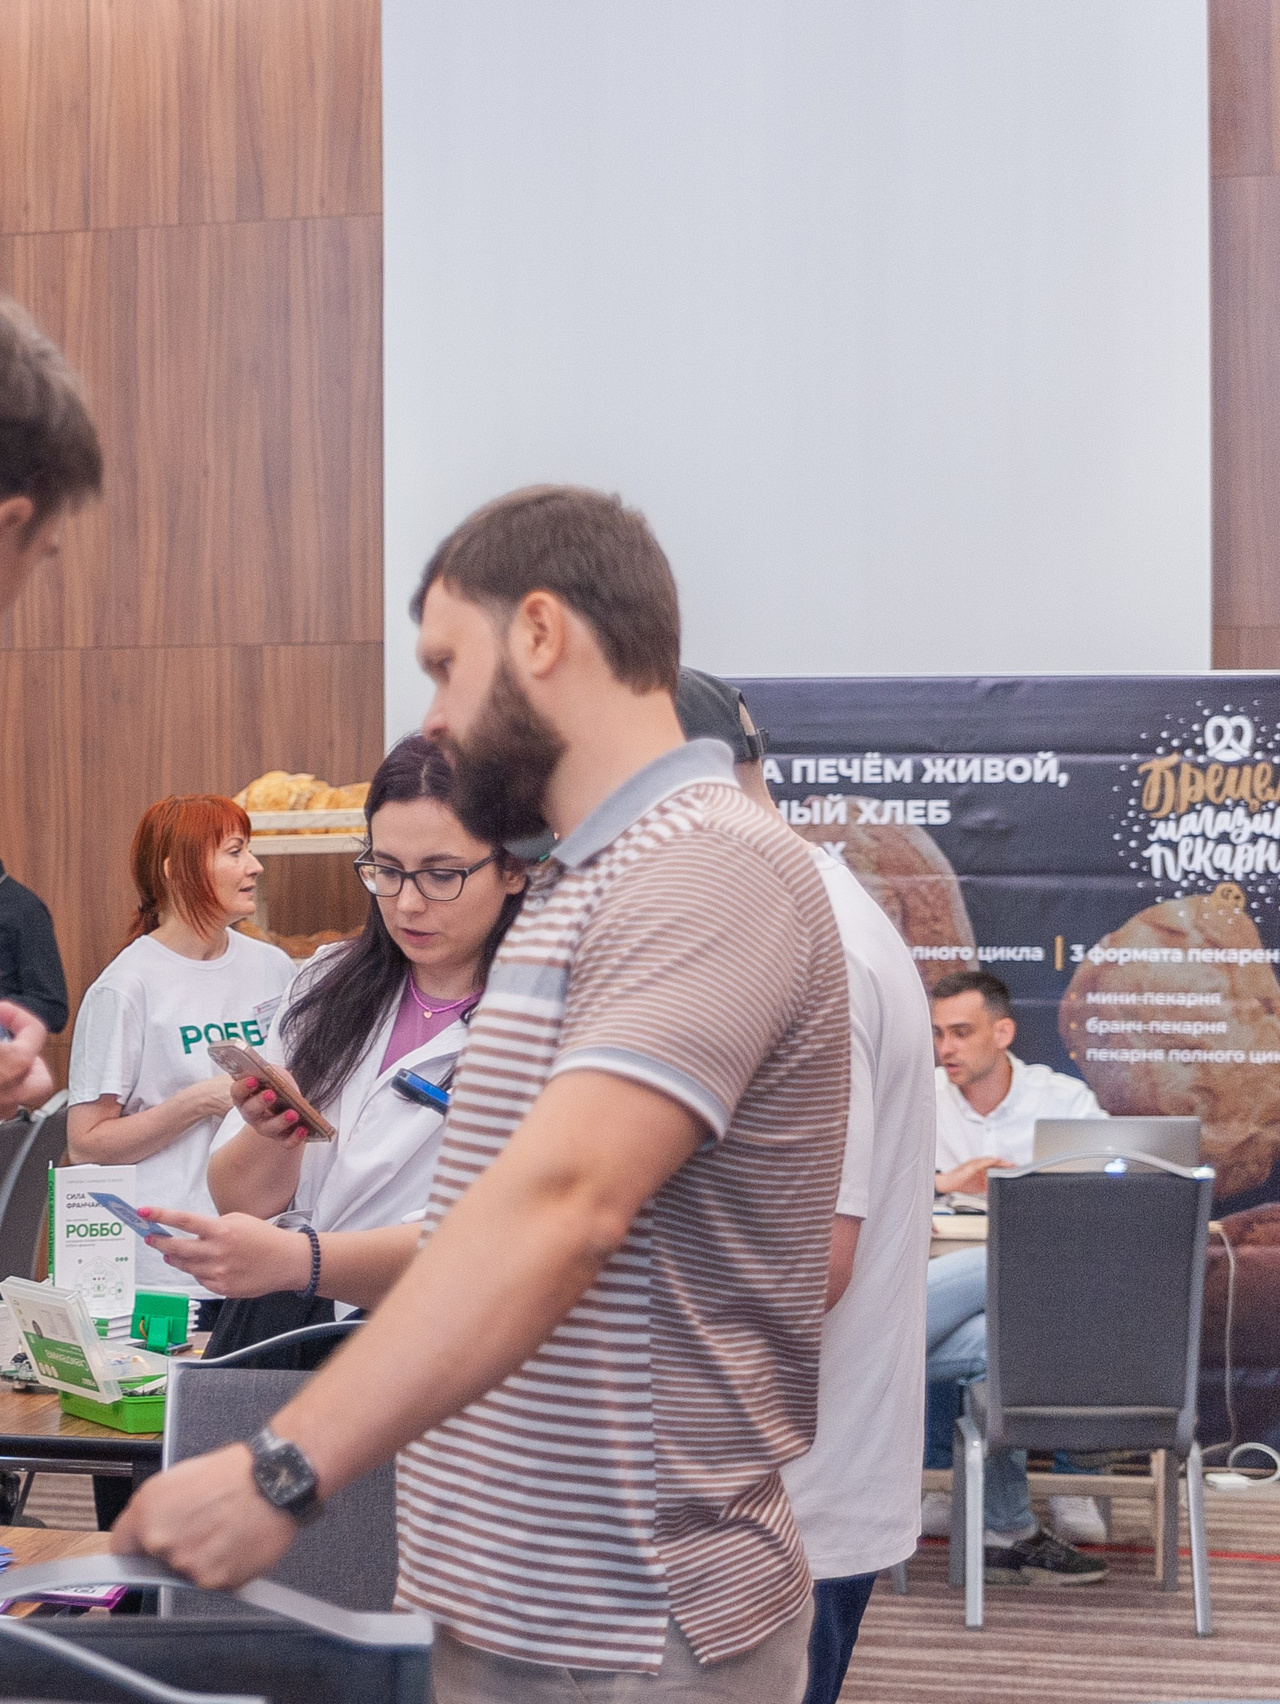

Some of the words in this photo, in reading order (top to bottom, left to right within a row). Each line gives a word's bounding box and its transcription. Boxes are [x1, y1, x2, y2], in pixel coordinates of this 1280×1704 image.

[792, 752, 913, 783] ПЕЧЁМ
[921, 750, 1069, 787] ЖИВОЙ,
[856, 800, 951, 826] ХЛЕБ
[978, 946, 1044, 963] цикла
[1070, 944, 1085, 962] 3
[1088, 945, 1184, 966] формата
[1086, 992, 1221, 1008] мини-пекарня
[1086, 1016, 1228, 1037] бранч-пекарня
[1086, 1048, 1165, 1065] пекарня
[1168, 1049, 1246, 1063] полного
[66, 1222, 122, 1238] РОББО
